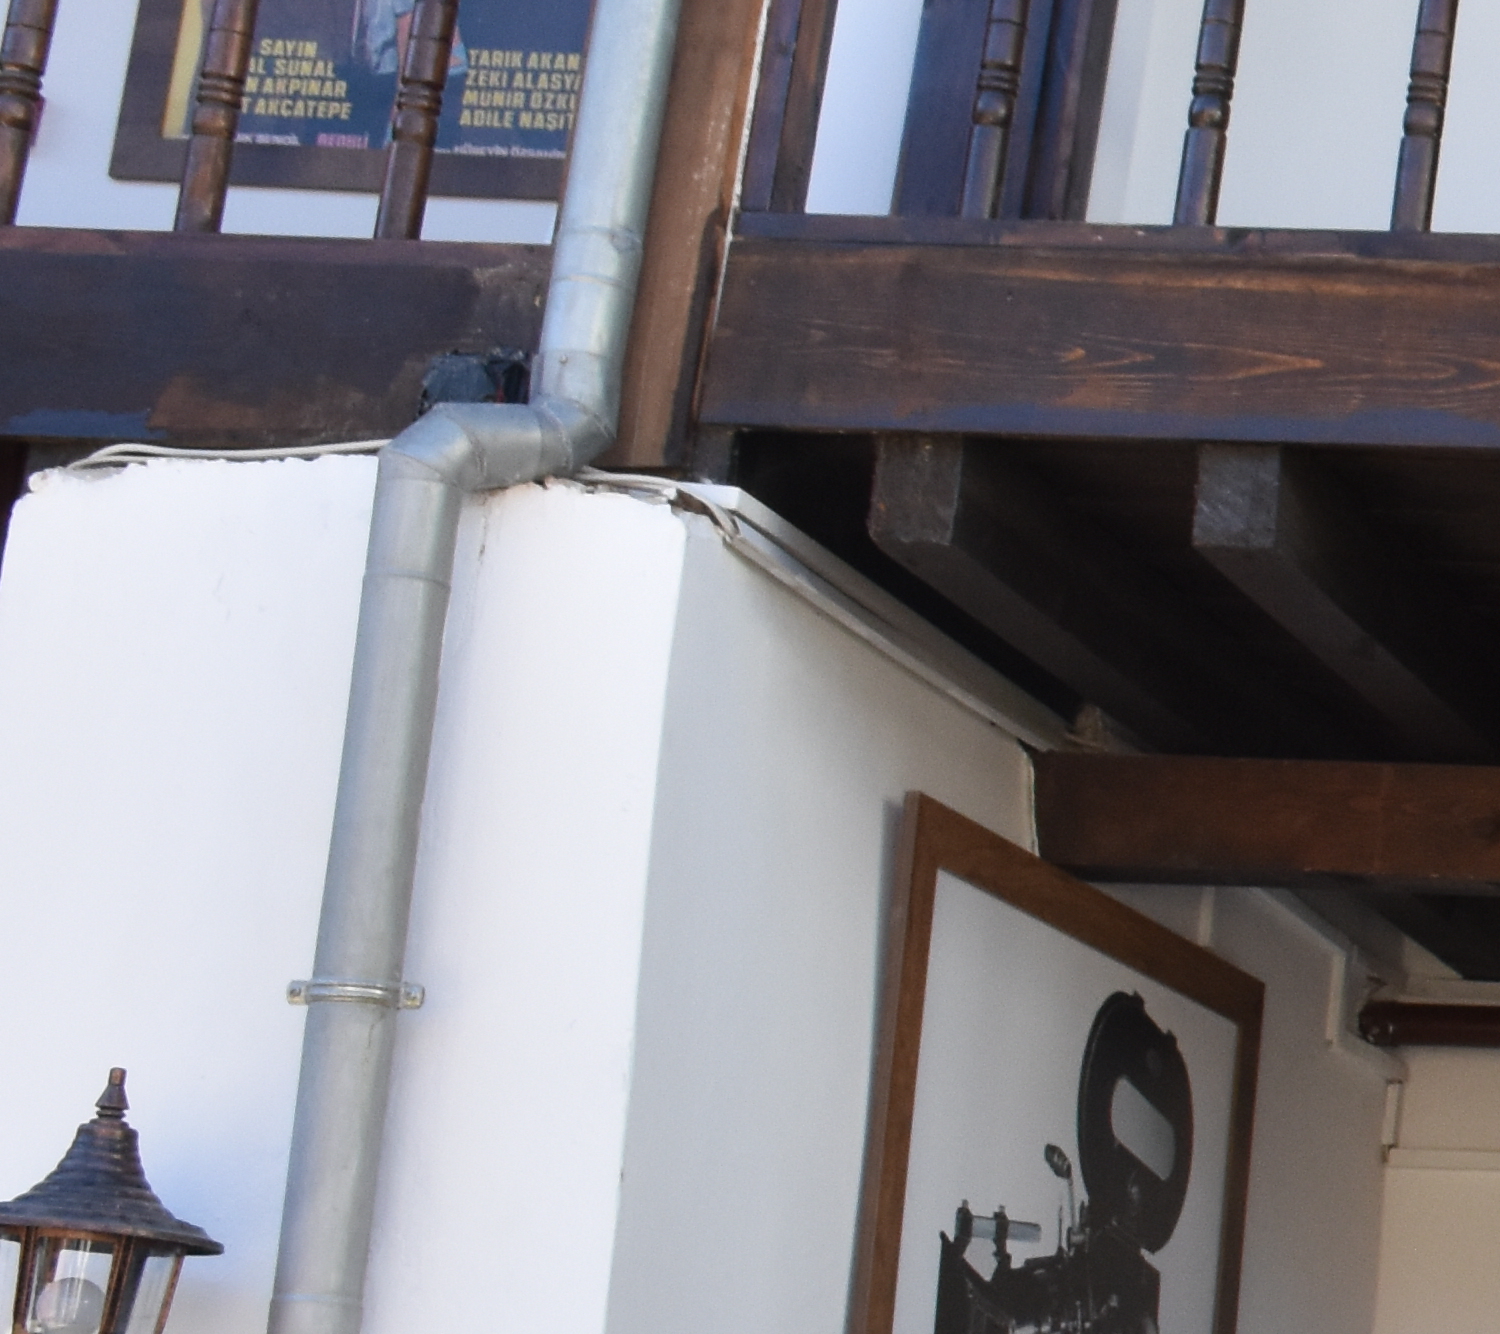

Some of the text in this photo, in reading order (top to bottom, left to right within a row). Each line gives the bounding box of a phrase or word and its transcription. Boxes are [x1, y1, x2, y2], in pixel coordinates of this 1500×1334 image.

[260, 38, 318, 57] SAYIN
[273, 59, 335, 78] SUNAL
[469, 48, 580, 70] TARIK AKAN
[263, 77, 347, 97] AKPINAR
